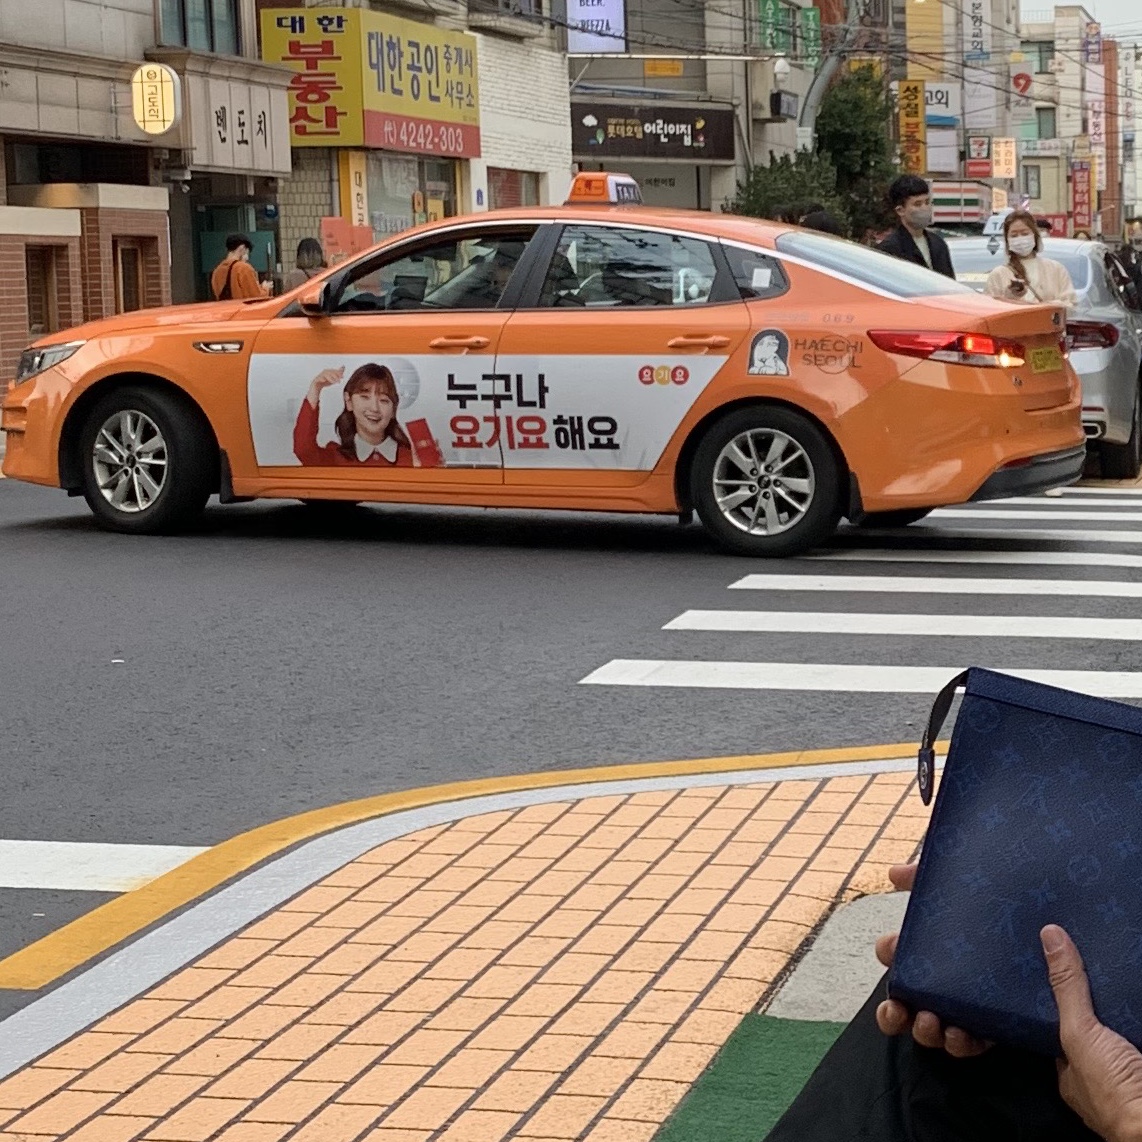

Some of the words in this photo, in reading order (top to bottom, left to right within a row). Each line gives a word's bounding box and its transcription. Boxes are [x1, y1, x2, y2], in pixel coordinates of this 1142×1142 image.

[276, 15, 348, 34] 대한
[367, 31, 441, 103] 대한공인
[443, 44, 474, 78] 중개사
[281, 40, 348, 136] 부동산
[444, 79, 475, 110] 사무소
[399, 122, 464, 154] 4242-303
[643, 118, 692, 147] 어린이집
[794, 338, 863, 354] HAECHI
[802, 353, 862, 369] SEOUL
[640, 366, 687, 384] 요기요
[446, 372, 550, 410] 누구나
